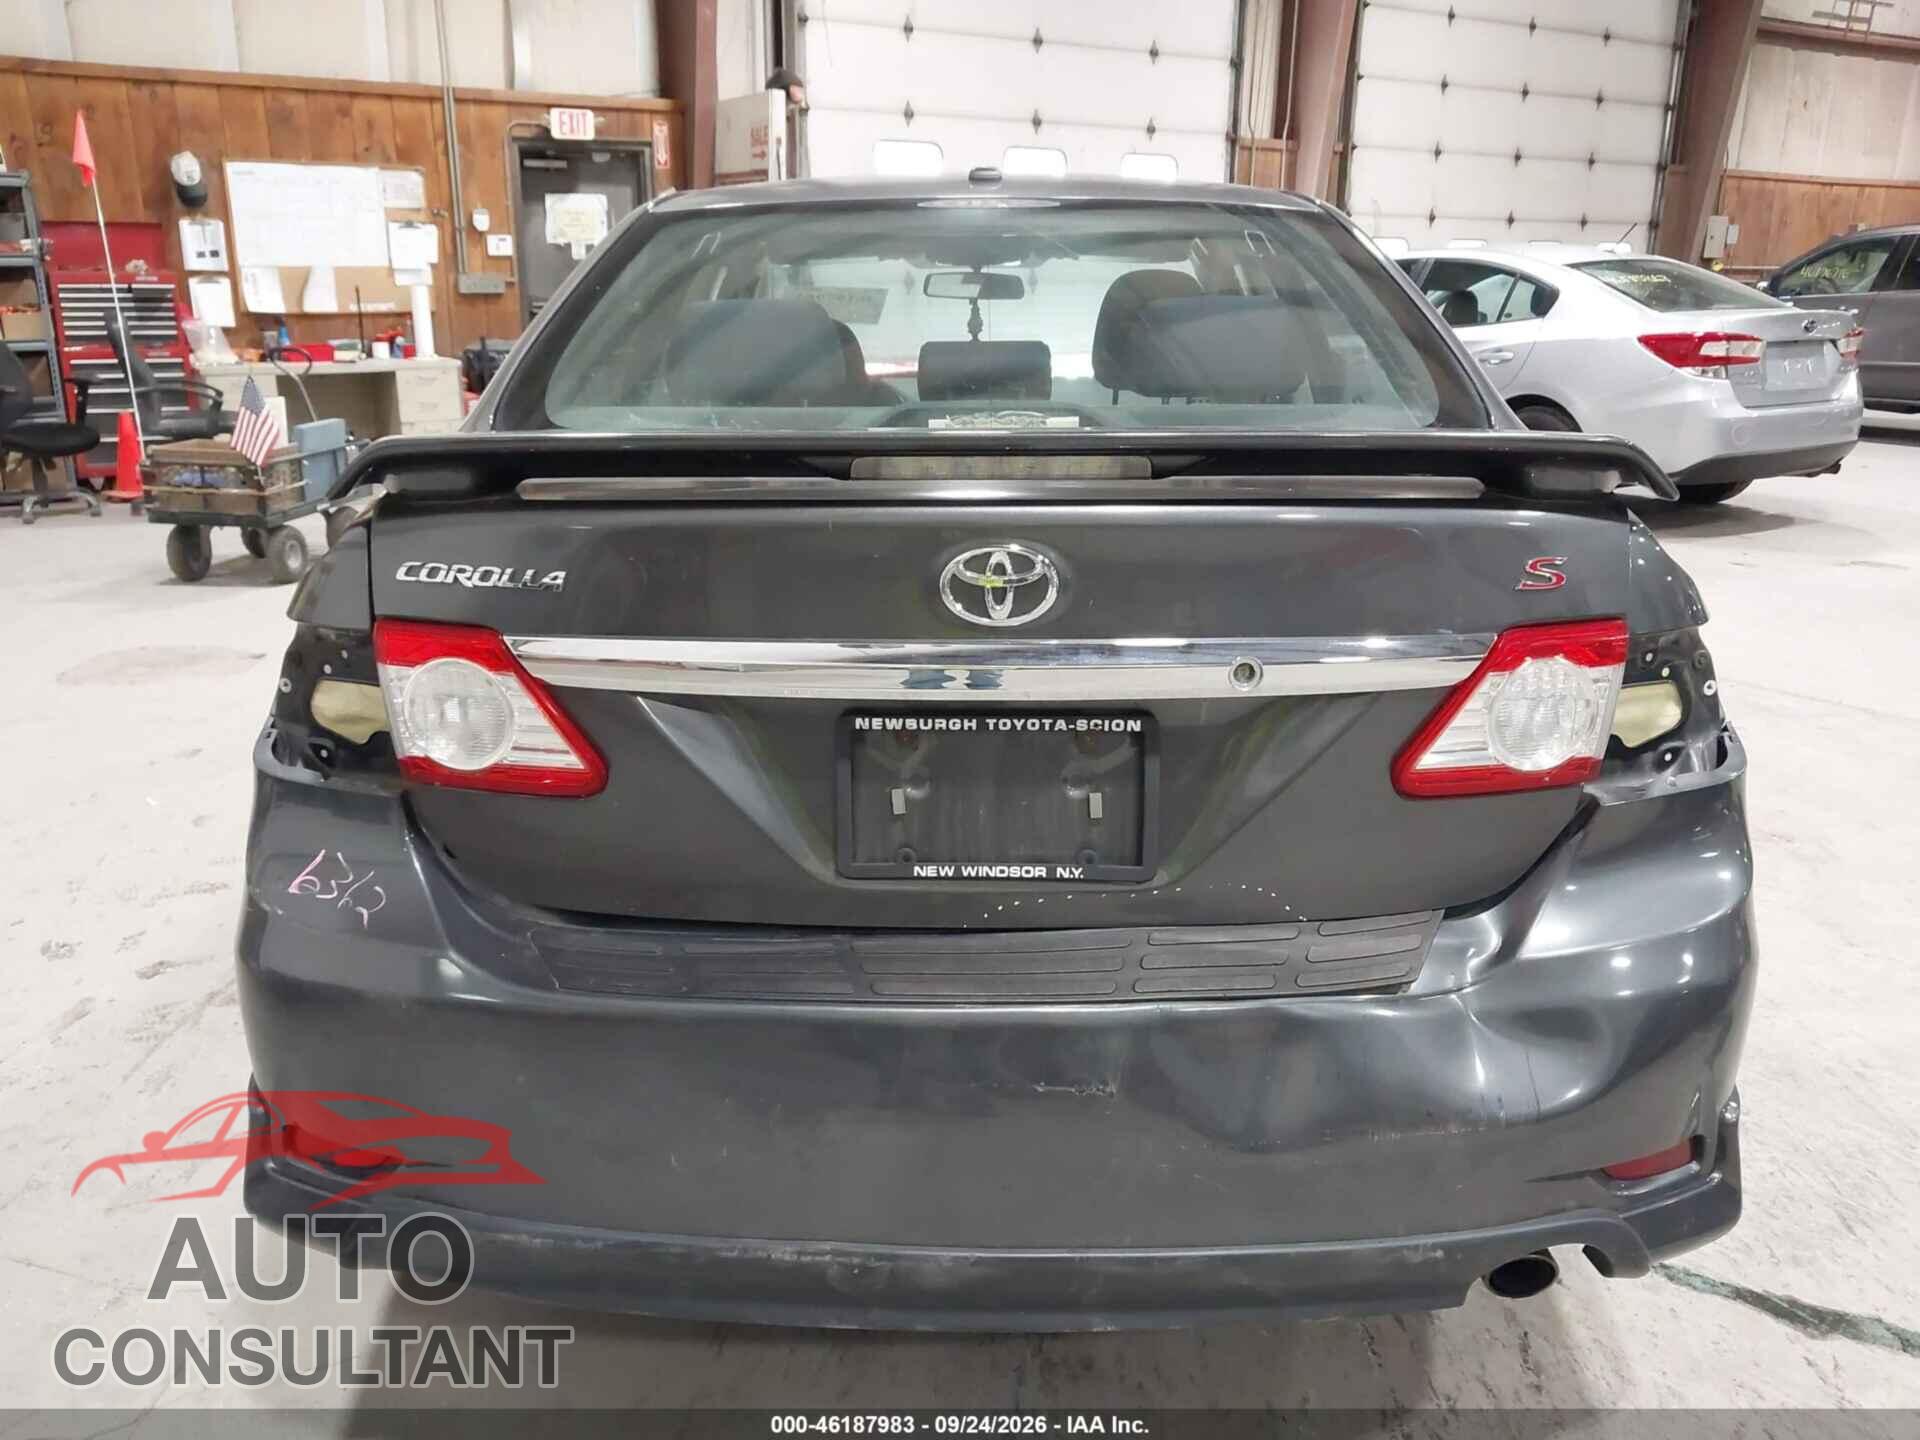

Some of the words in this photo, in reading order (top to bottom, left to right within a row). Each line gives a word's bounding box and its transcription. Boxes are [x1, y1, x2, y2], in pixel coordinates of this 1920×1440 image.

[558, 110, 588, 137] EXIT
[395, 561, 567, 592] COROLLA
[1515, 556, 1568, 590] S
[854, 716, 978, 731] NEWBURGH
[985, 717, 1142, 733] TOYOTA-SCION
[912, 864, 956, 878] NEW
[961, 864, 1047, 879] WINDSOR
[1055, 866, 1085, 880] N.Y.
